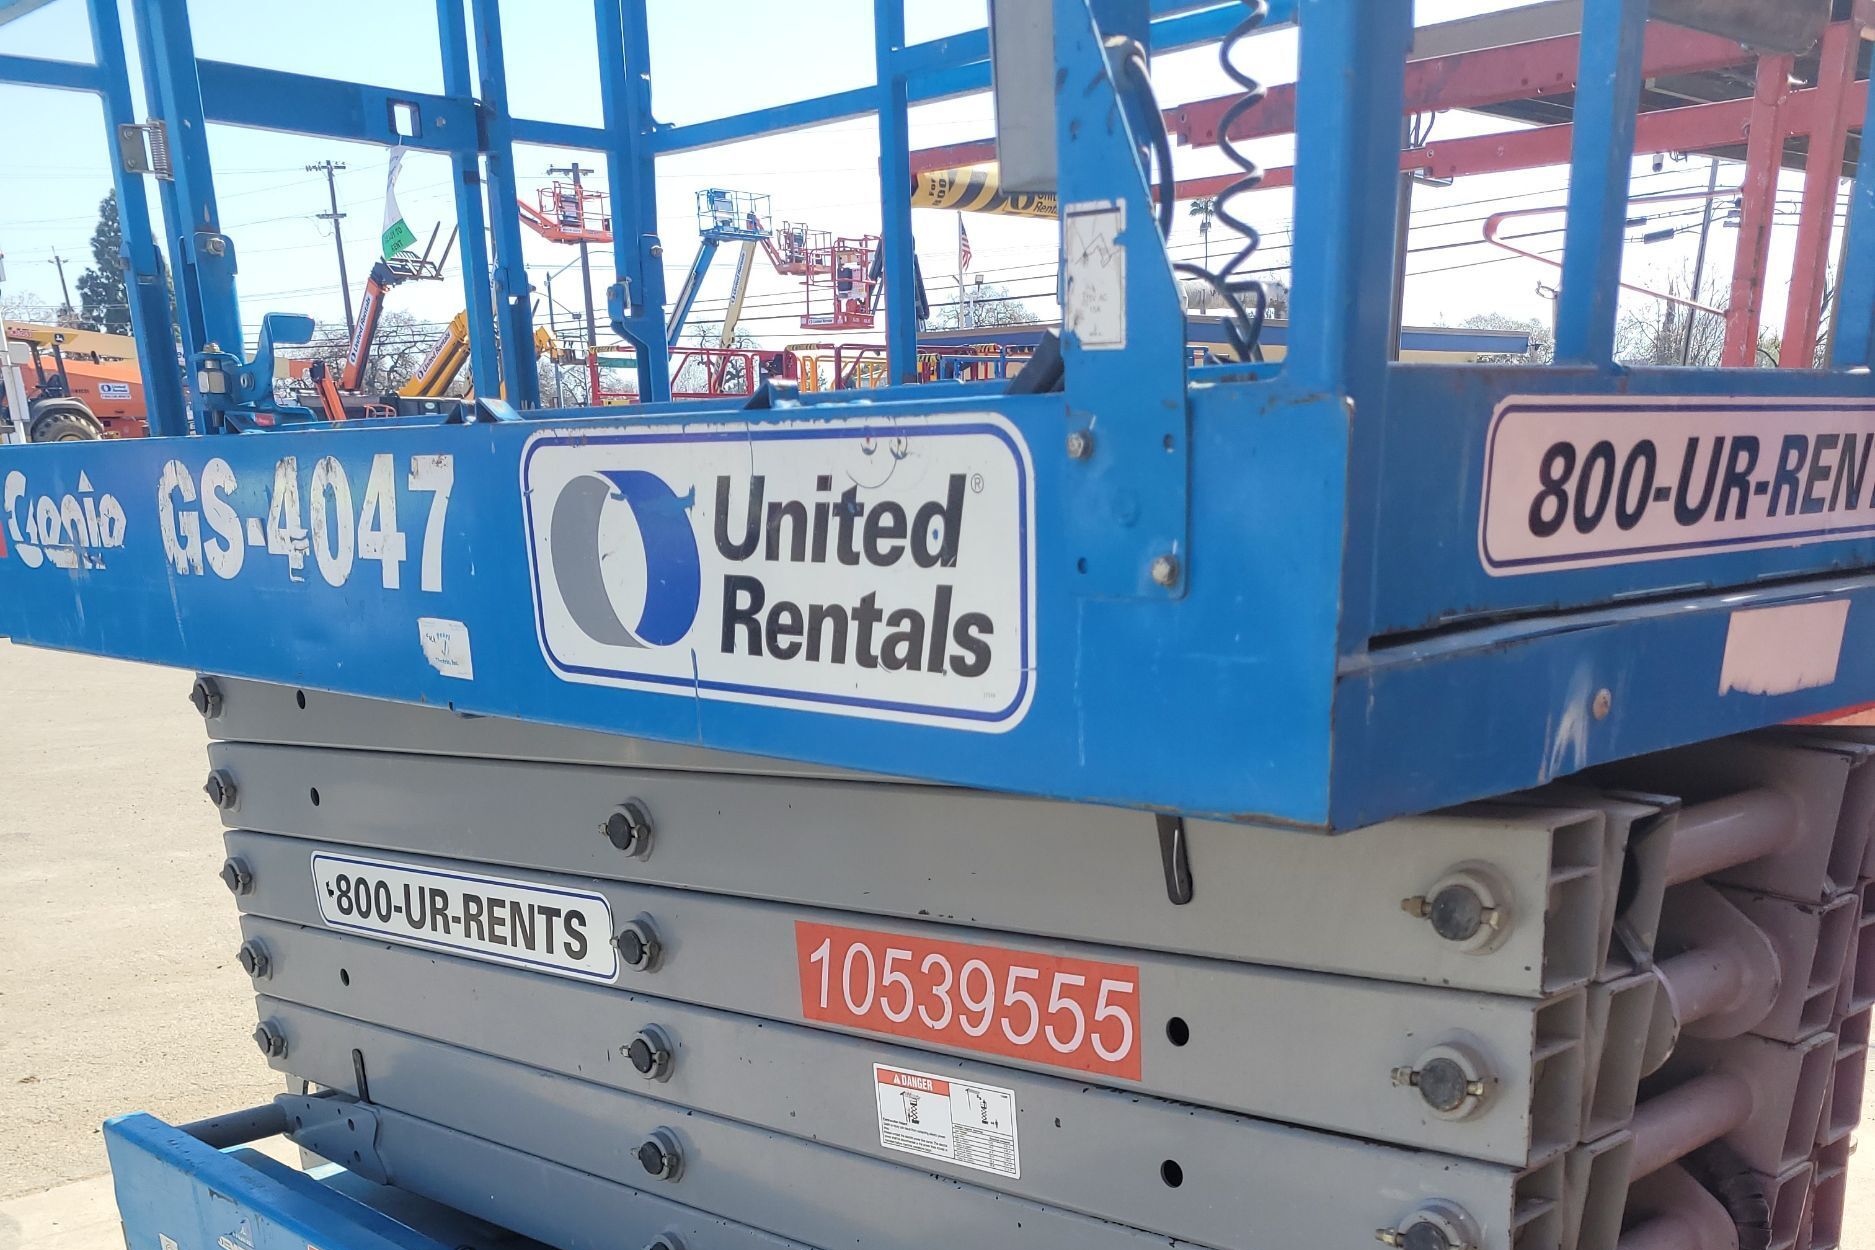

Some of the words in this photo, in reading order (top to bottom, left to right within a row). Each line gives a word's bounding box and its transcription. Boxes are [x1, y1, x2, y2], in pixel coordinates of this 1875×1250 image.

[157, 453, 454, 592] GS-4047
[1528, 432, 1875, 538] 800-UR-REN
[720, 574, 994, 677] Rentals
[810, 938, 1134, 1062] 10539555
[901, 1074, 933, 1091] DANGER
